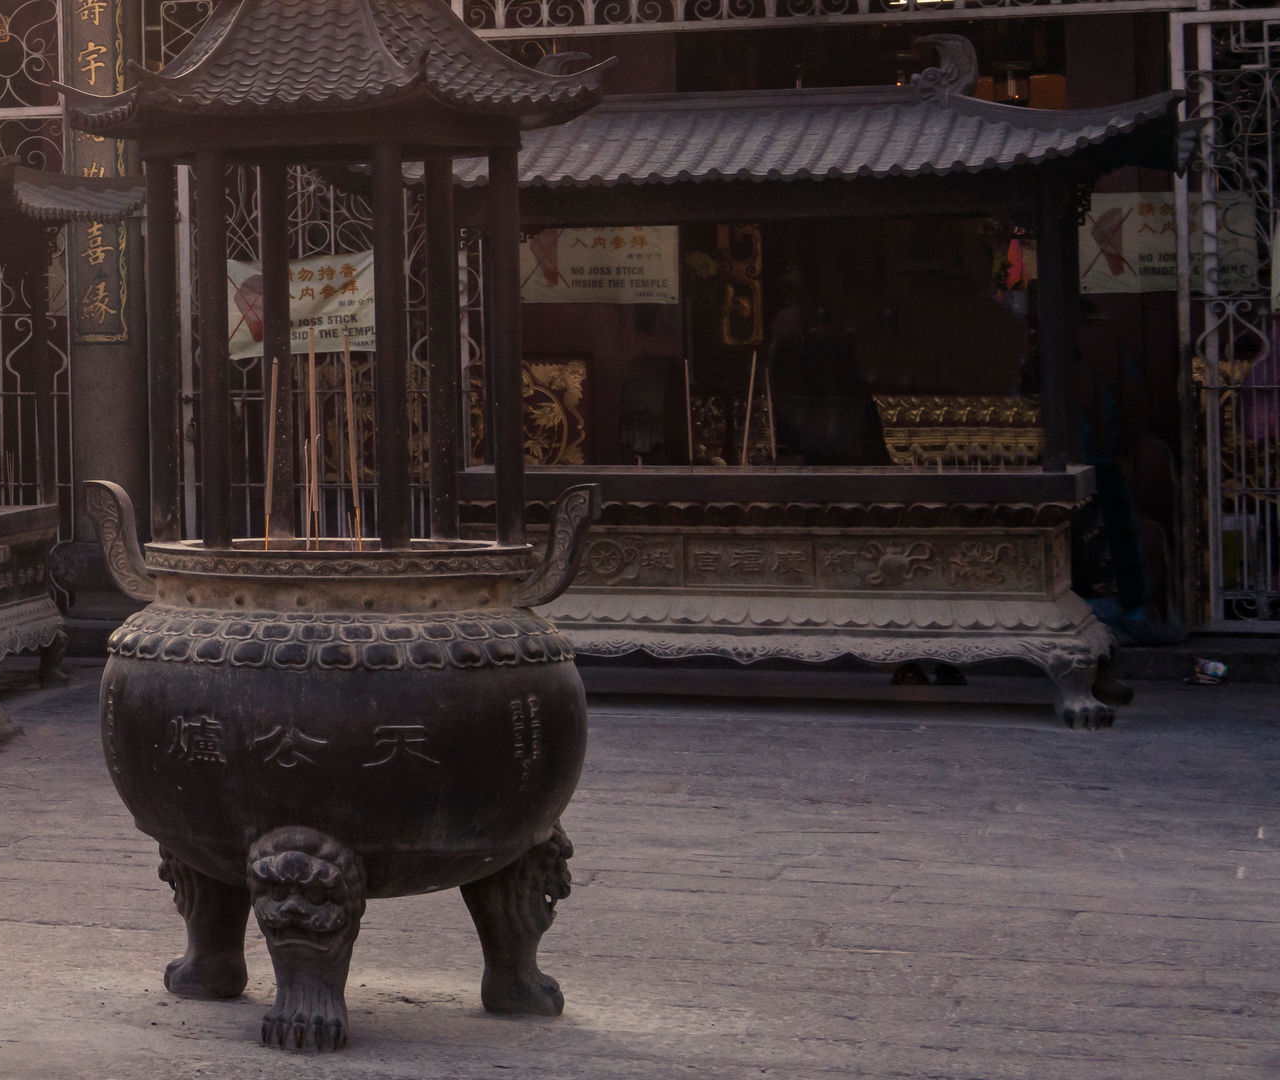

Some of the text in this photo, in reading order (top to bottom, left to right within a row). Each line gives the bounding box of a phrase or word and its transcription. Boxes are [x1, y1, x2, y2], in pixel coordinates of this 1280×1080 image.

[1159, 253, 1177, 262] JOS
[571, 266, 645, 275] NO JOSS STICK
[571, 279, 669, 288] INSIDE THE TEMPLE
[298, 317, 323, 327] JOSS
[327, 313, 358, 325] STICK
[318, 328, 339, 339] THE
[349, 340, 370, 348] THANK
